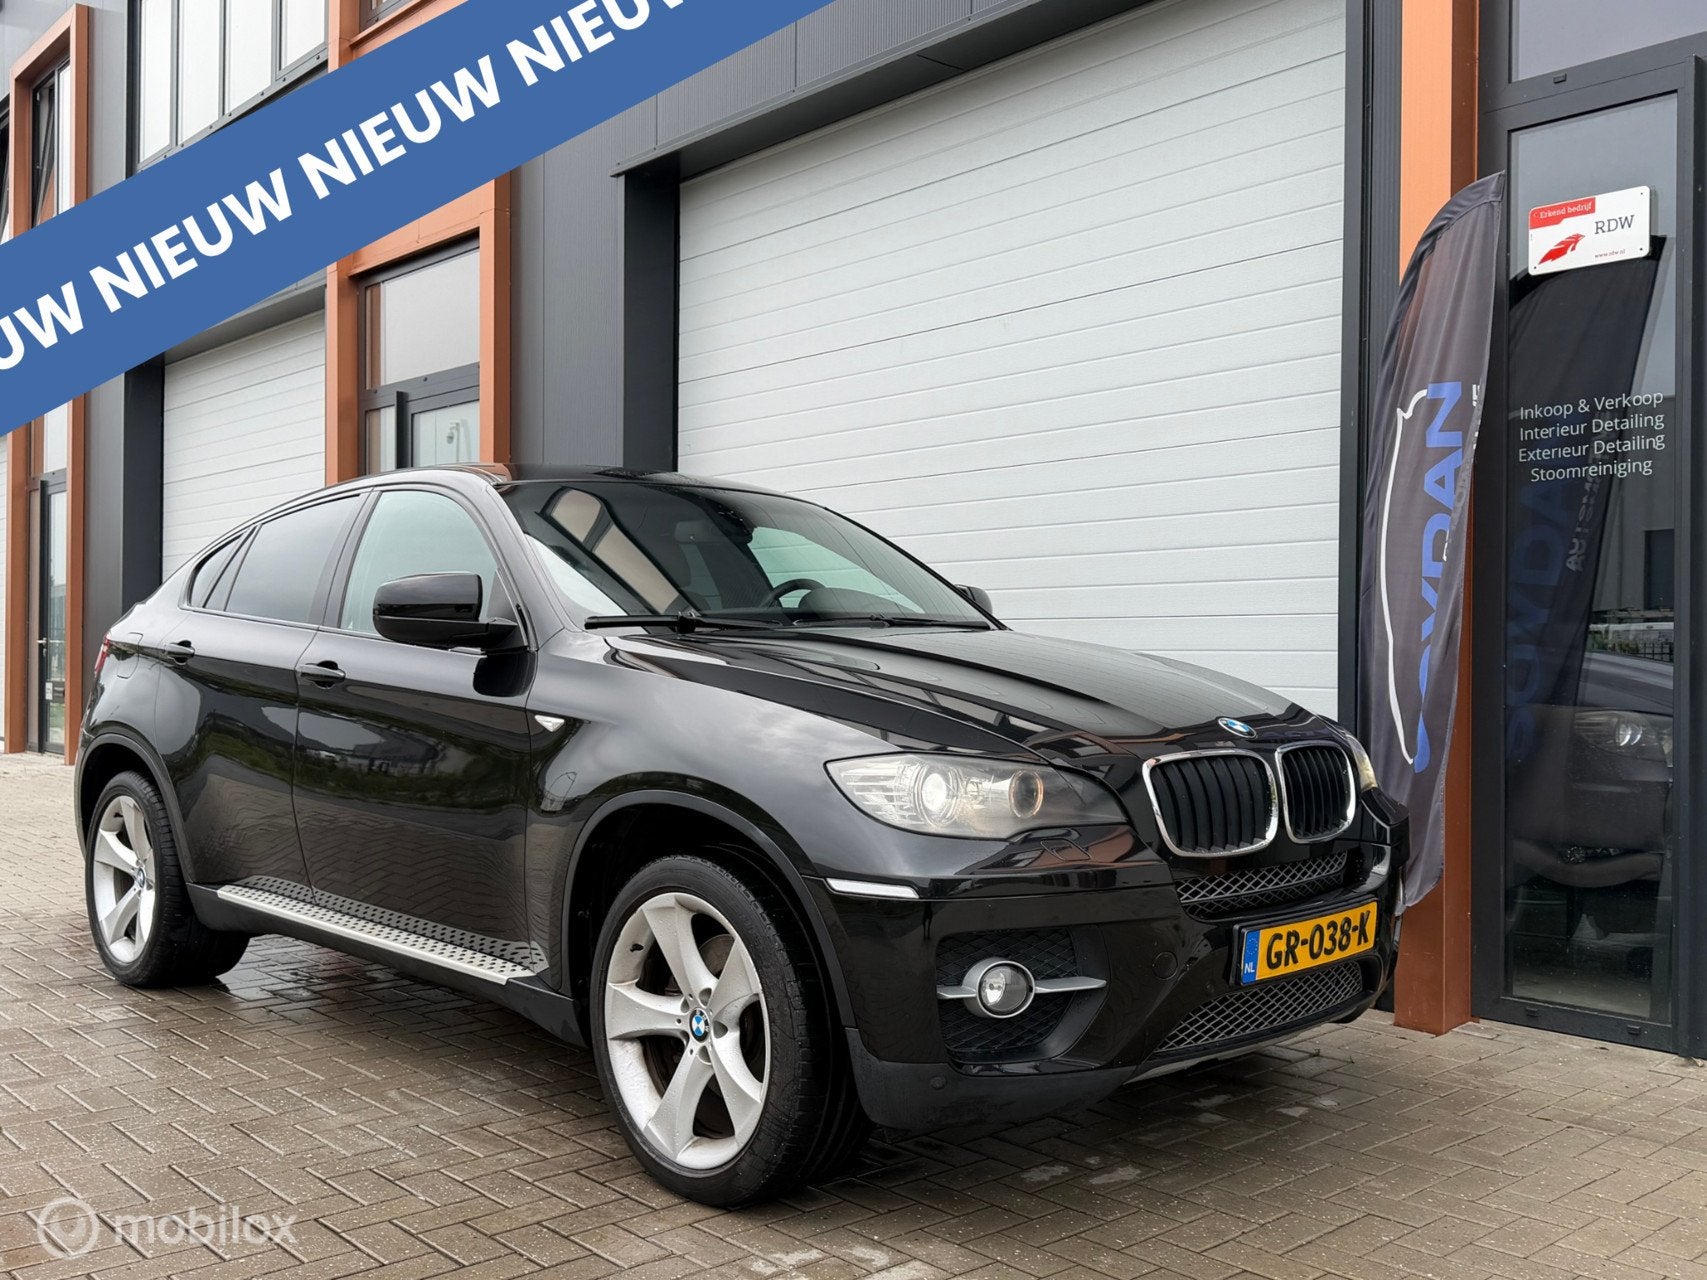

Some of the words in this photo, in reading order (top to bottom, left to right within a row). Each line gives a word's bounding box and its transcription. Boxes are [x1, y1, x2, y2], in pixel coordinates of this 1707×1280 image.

[1540, 207, 1566, 219] Erkend
[1567, 201, 1593, 214] bedrijf
[1594, 214, 1635, 235] RDW
[1520, 403, 1573, 420] Inkoop
[1578, 399, 1590, 413] &
[1594, 392, 1664, 411] Verkoop
[1520, 423, 1587, 441] Interieur
[1592, 414, 1665, 433] Detailing
[1518, 444, 1589, 462] Exterieur
[1594, 434, 1665, 455] Detailing
[1531, 458, 1653, 482] Stoomreiniging
[1266, 910, 1371, 970] GR-038-K
[1244, 963, 1255, 974] NL
